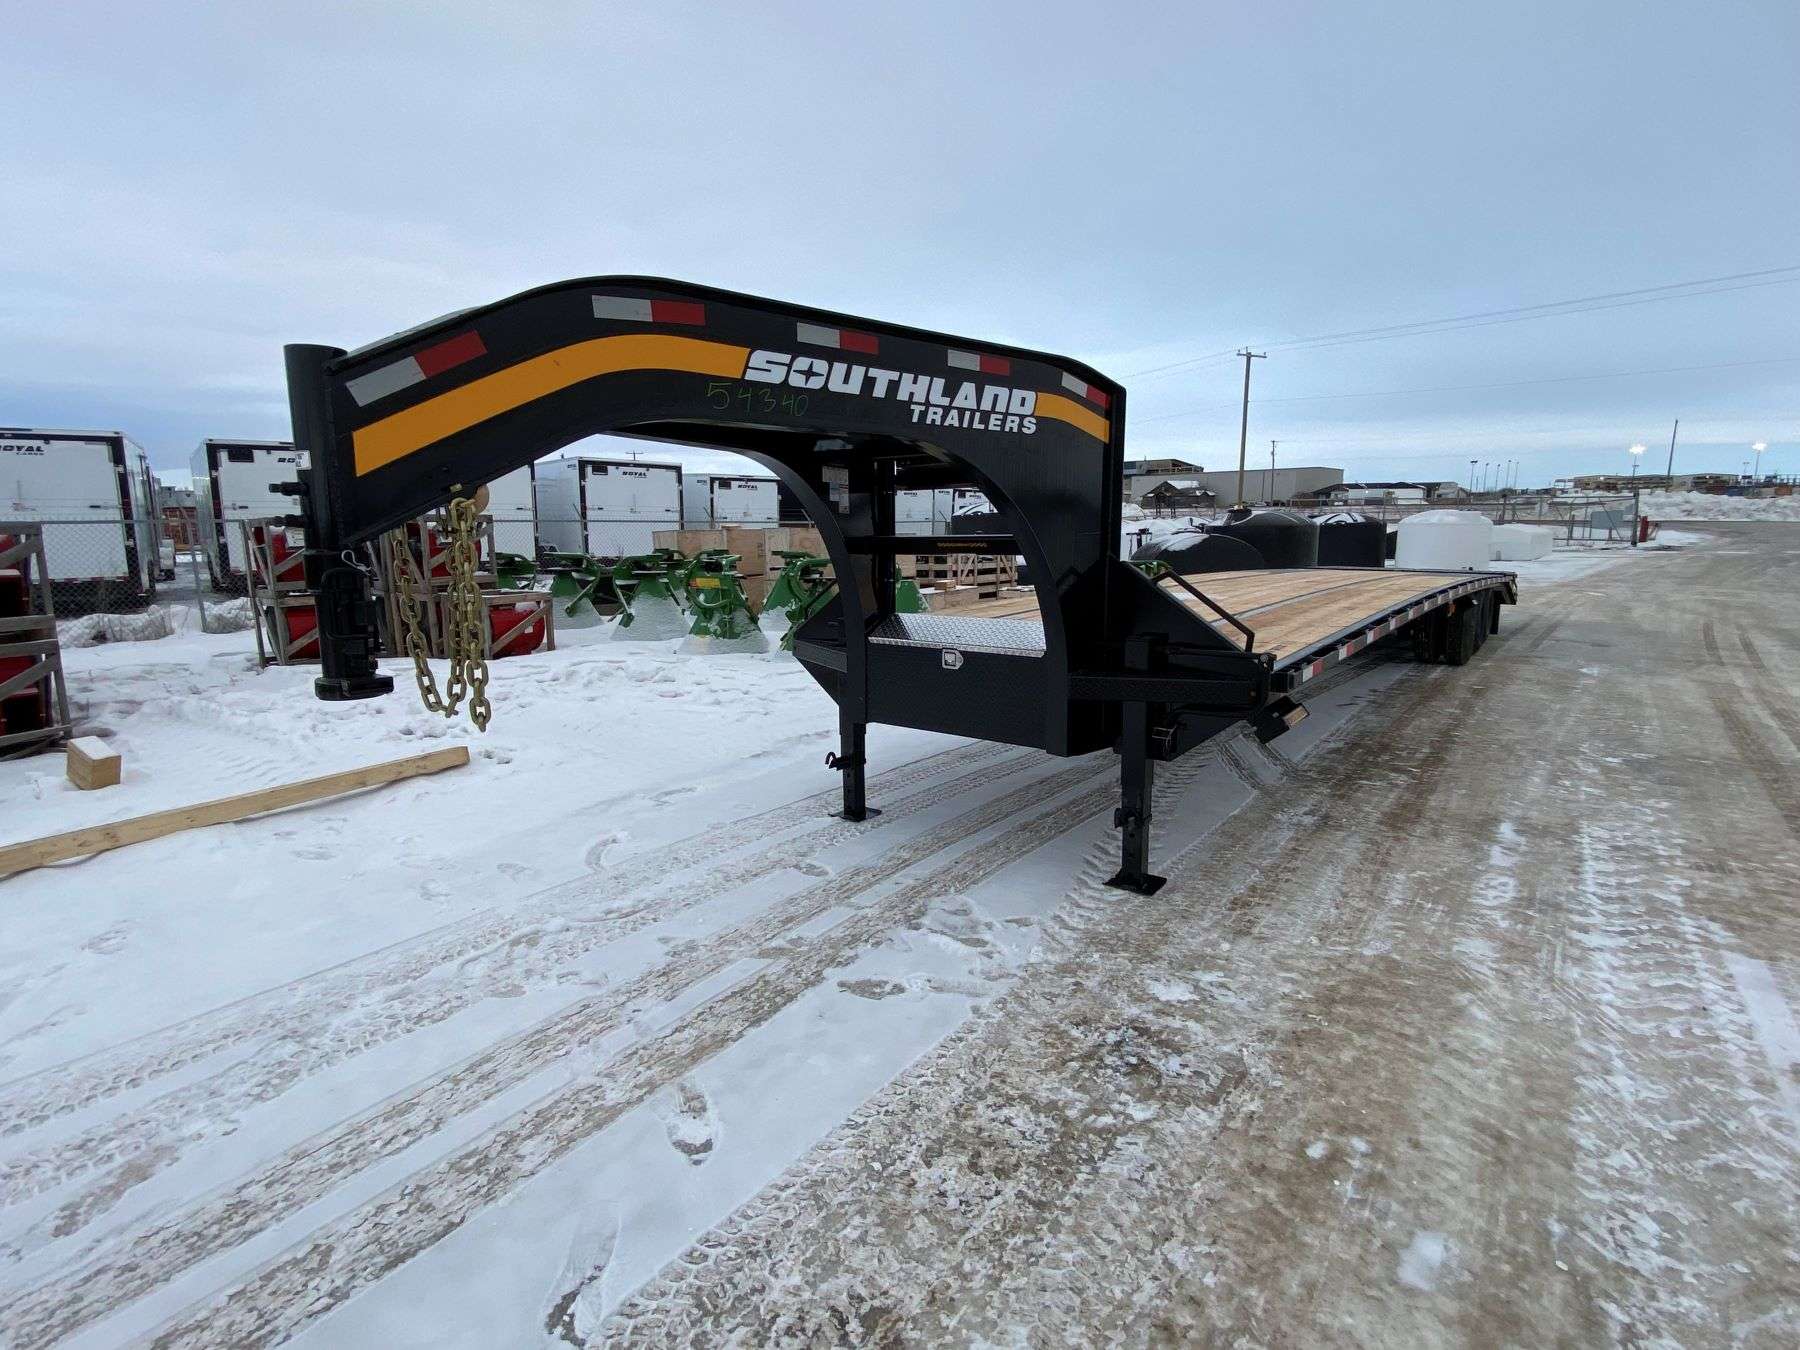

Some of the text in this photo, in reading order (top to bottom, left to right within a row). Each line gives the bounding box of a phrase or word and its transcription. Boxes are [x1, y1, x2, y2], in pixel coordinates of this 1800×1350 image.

[706, 382, 809, 417] 54340
[744, 350, 1037, 416] SOUTHLAND
[910, 404, 1037, 435] TRAILERS
